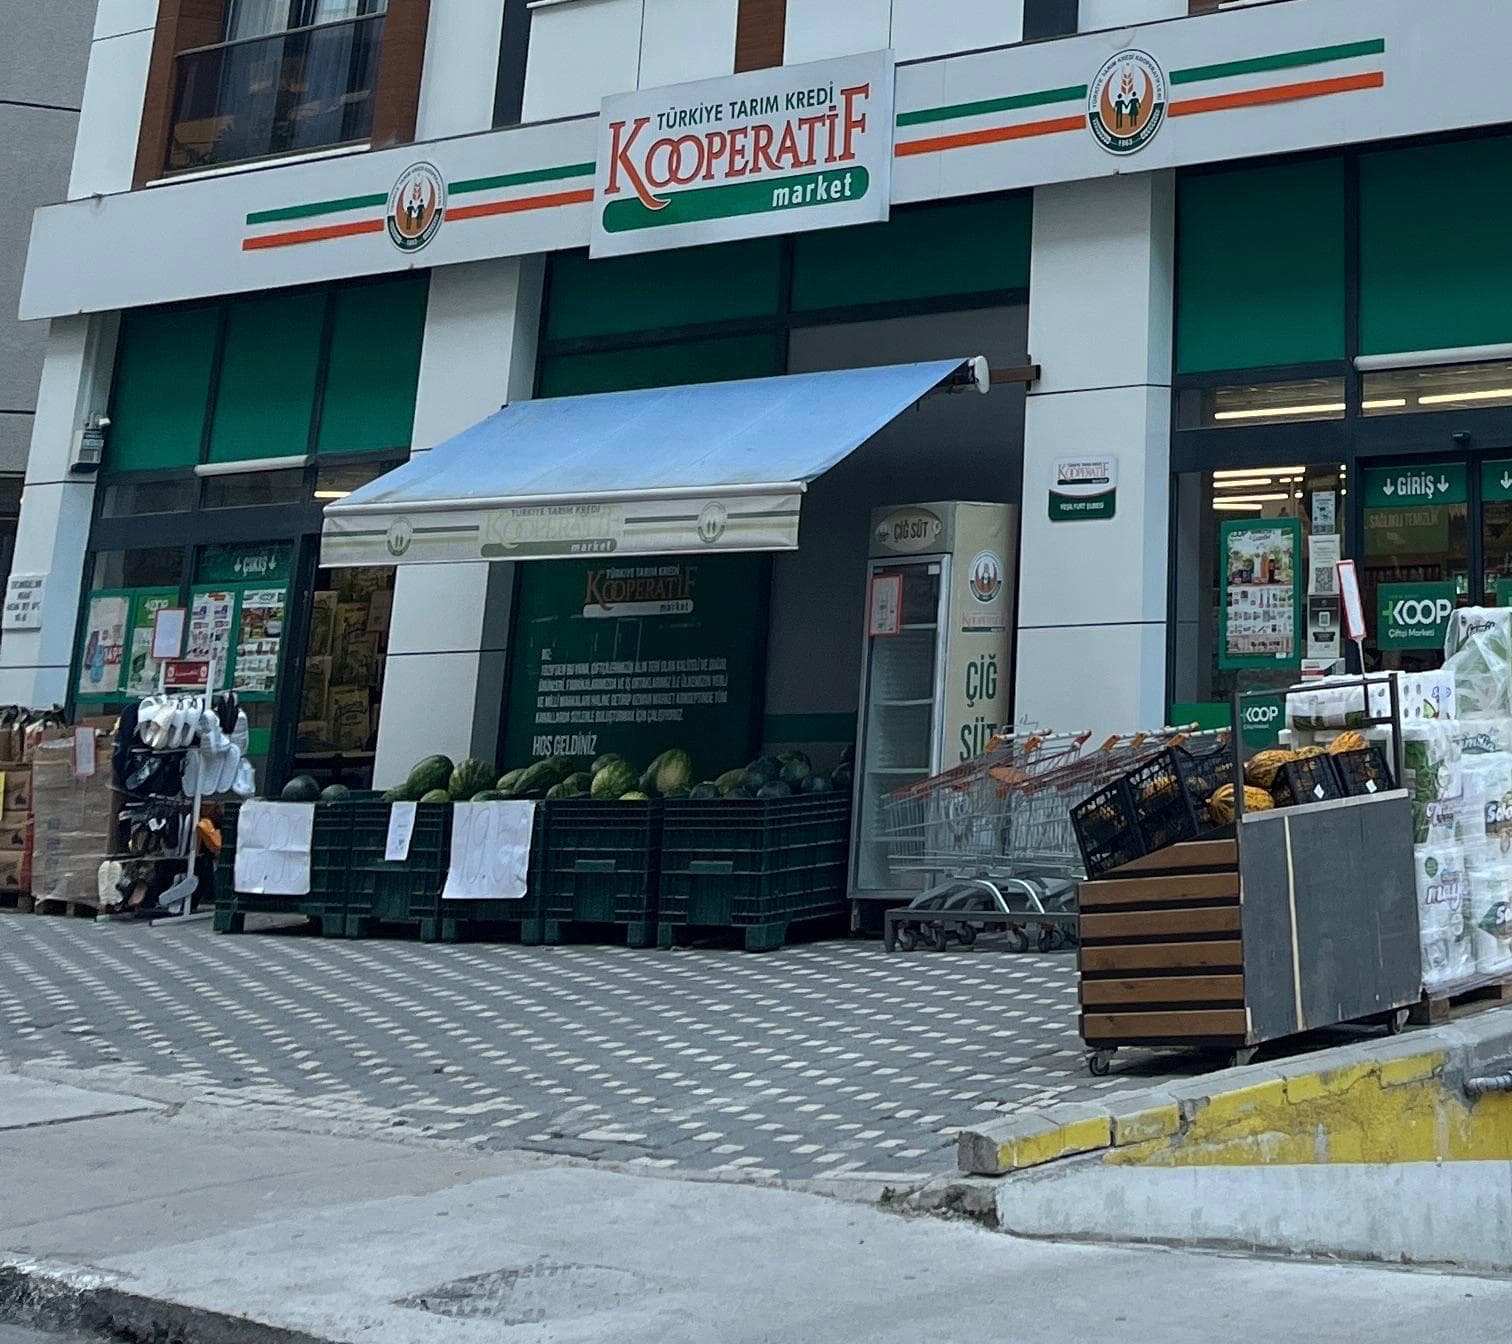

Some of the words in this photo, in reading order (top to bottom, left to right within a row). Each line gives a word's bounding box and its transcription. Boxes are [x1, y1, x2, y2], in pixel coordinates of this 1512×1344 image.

[657, 102, 723, 131] TÜRKİYE
[729, 94, 779, 120] TARIM
[785, 80, 834, 110] KREDİ
[604, 82, 870, 211] KOOPERATİF
[772, 172, 852, 207] market
[1397, 471, 1435, 499] GİRİŞ
[893, 518, 909, 543] ÇİĞ
[910, 518, 929, 539] SÜT
[571, 540, 612, 553] market
[1383, 598, 1453, 625] KOOP
[965, 653, 998, 708] ÇİĞ
[1240, 706, 1279, 722] KOOP
[532, 734, 553, 757] HOŞ
[553, 731, 598, 756] GELDİNİZ
[960, 716, 998, 762] SÜT
